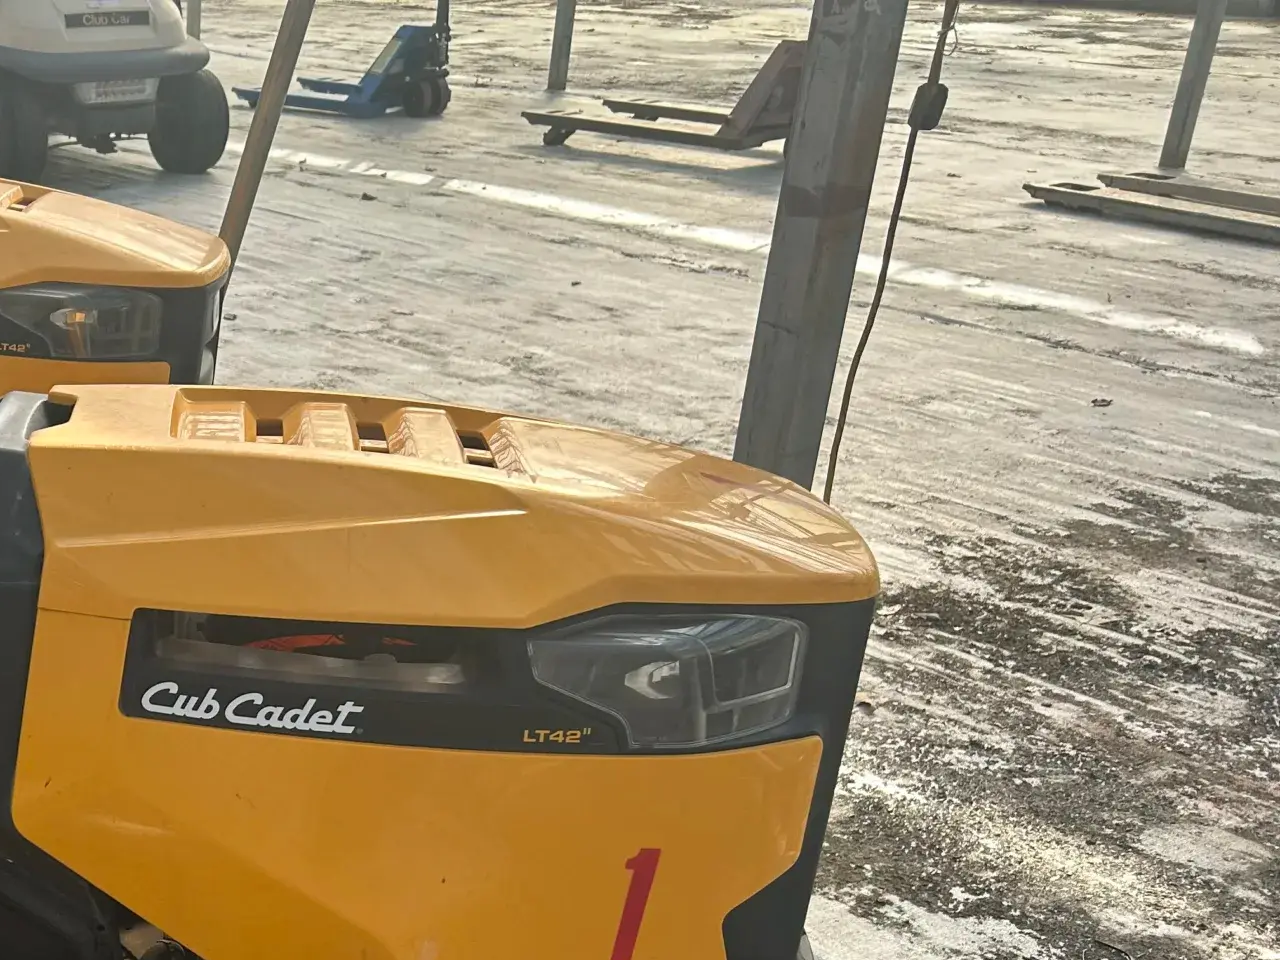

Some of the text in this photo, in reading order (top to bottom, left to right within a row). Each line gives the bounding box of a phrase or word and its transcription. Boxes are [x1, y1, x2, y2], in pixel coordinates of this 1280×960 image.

[82, 14, 130, 26] Club Car
[141, 681, 364, 734] Cub Cadet
[523, 727, 592, 743] LT42"
